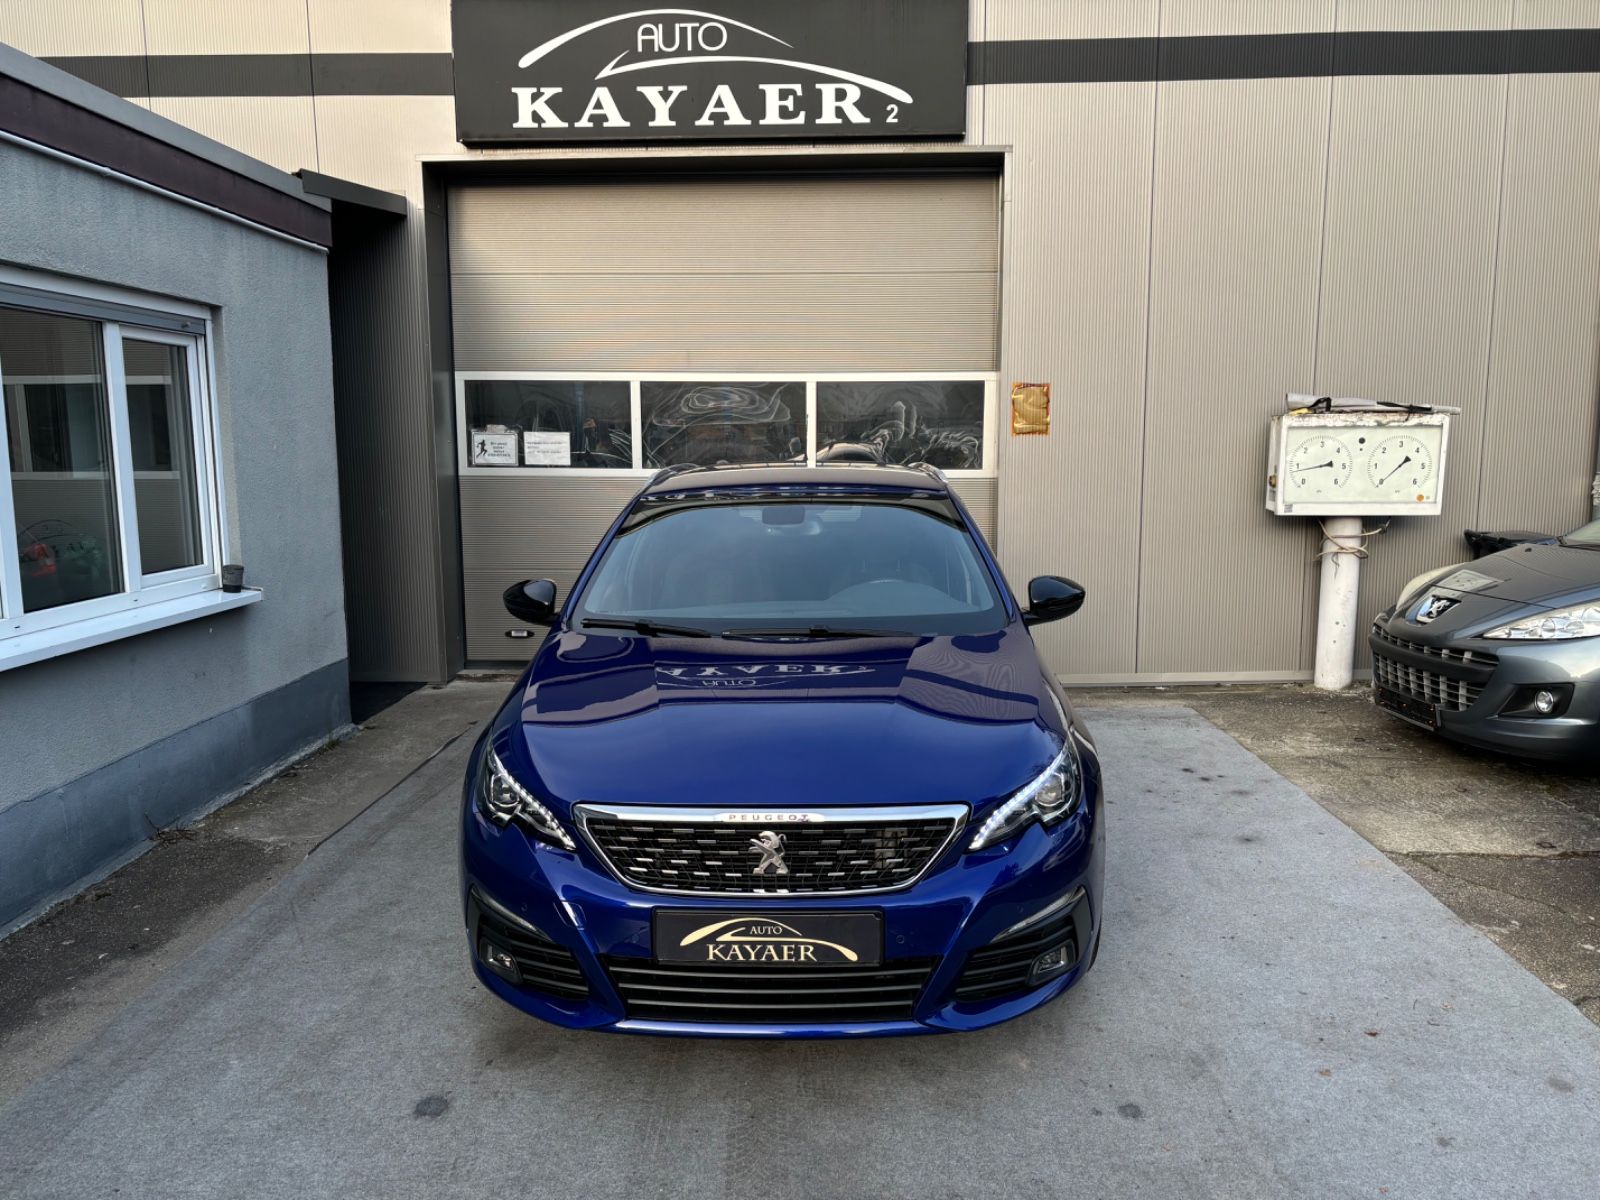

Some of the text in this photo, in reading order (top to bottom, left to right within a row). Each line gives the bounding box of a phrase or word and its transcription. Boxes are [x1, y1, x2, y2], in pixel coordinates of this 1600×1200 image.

[636, 22, 728, 53] AUTO
[511, 83, 899, 129] KAYAER 2
[750, 925, 782, 935] AUTO
[706, 943, 817, 962] KAYAER
